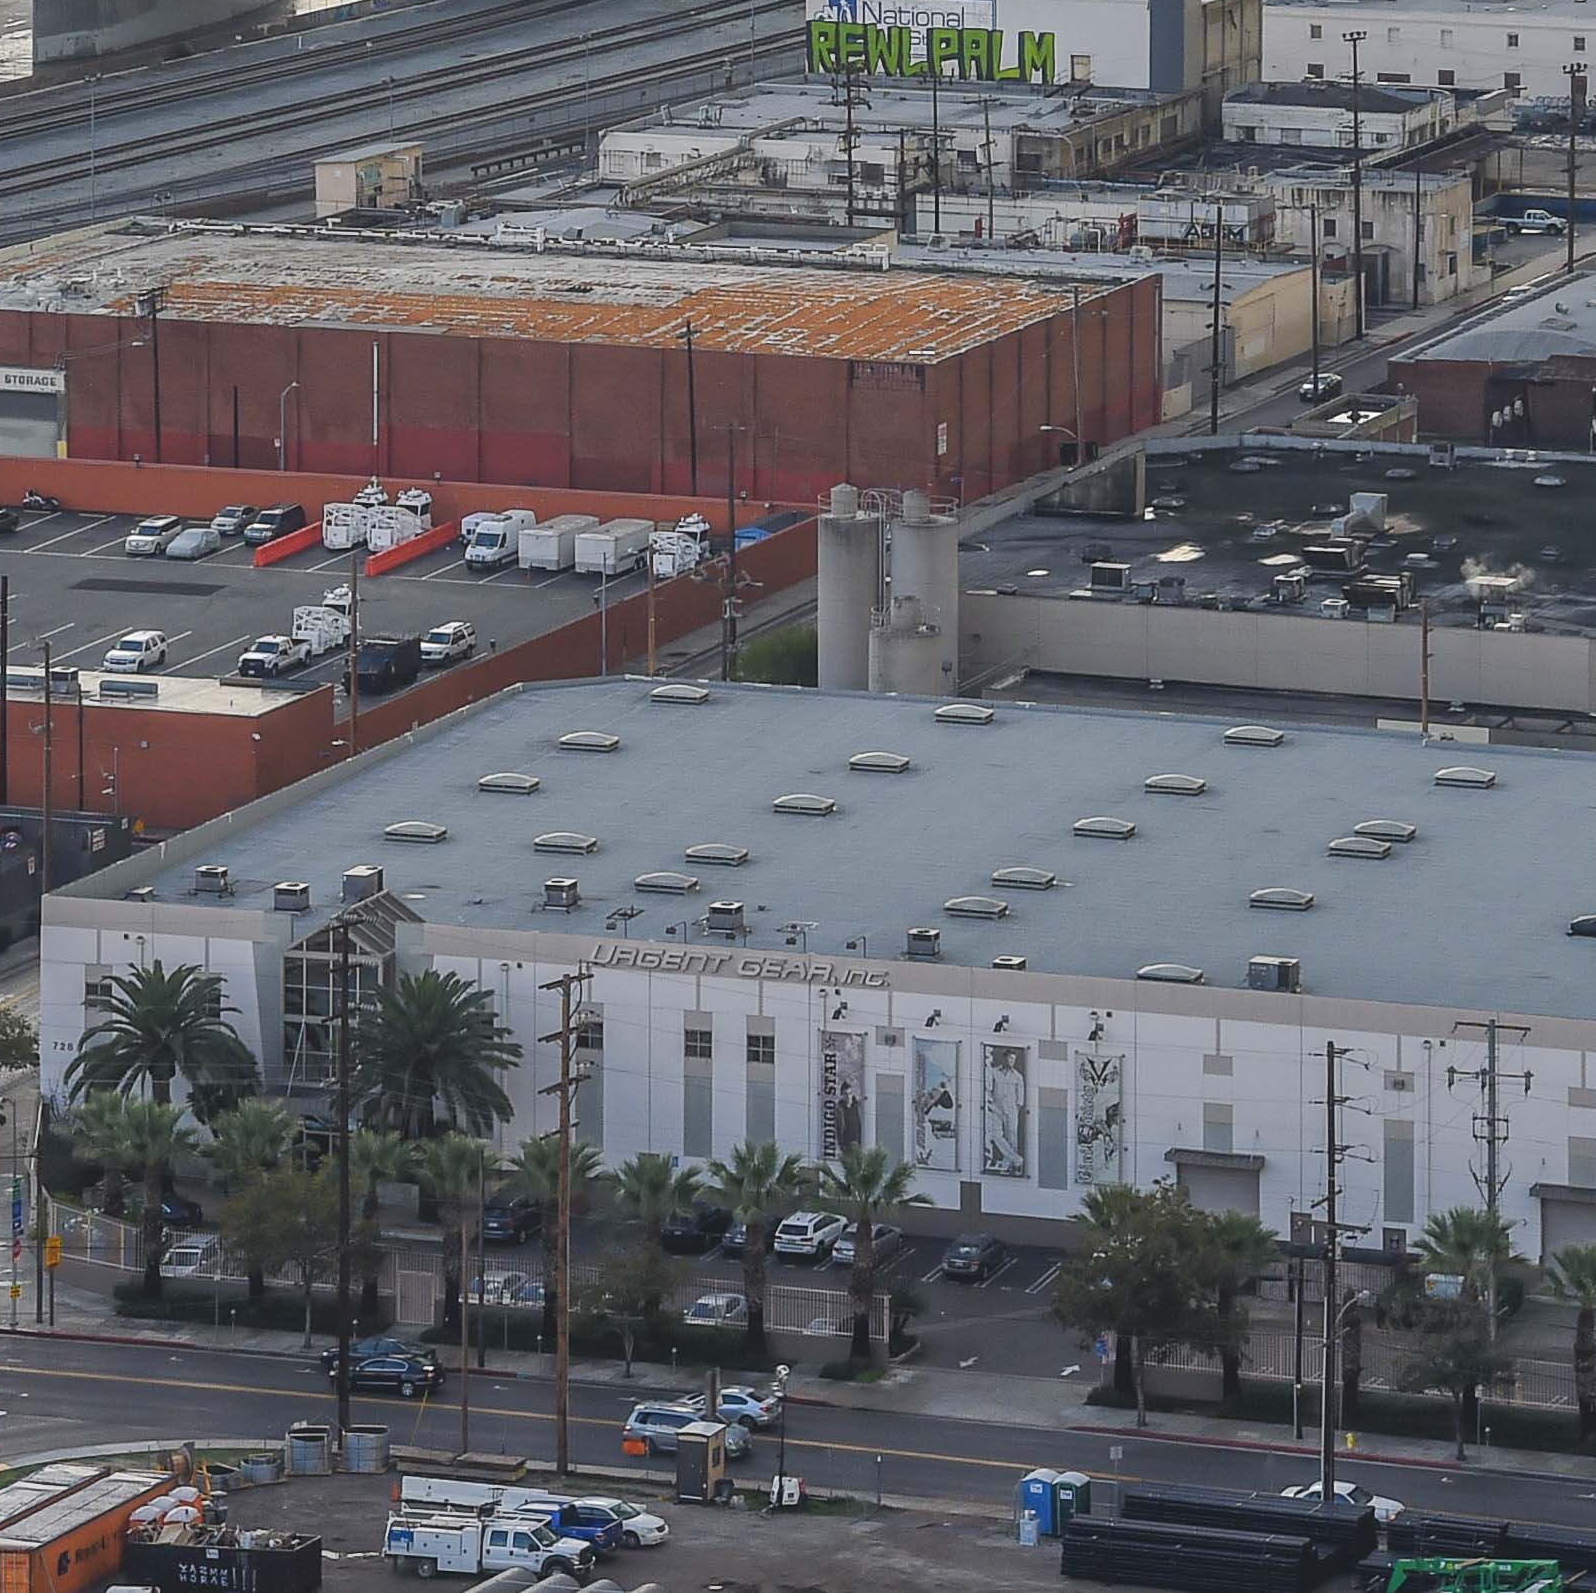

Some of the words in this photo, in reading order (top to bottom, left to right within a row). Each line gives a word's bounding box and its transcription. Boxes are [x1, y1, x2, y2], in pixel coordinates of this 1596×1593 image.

[862, 0, 965, 28] National
[4, 373, 57, 387] STORAGE
[590, 944, 731, 976] URGENT
[824, 1052, 838, 1098] STAR
[823, 1100, 838, 1160] INDIGO
